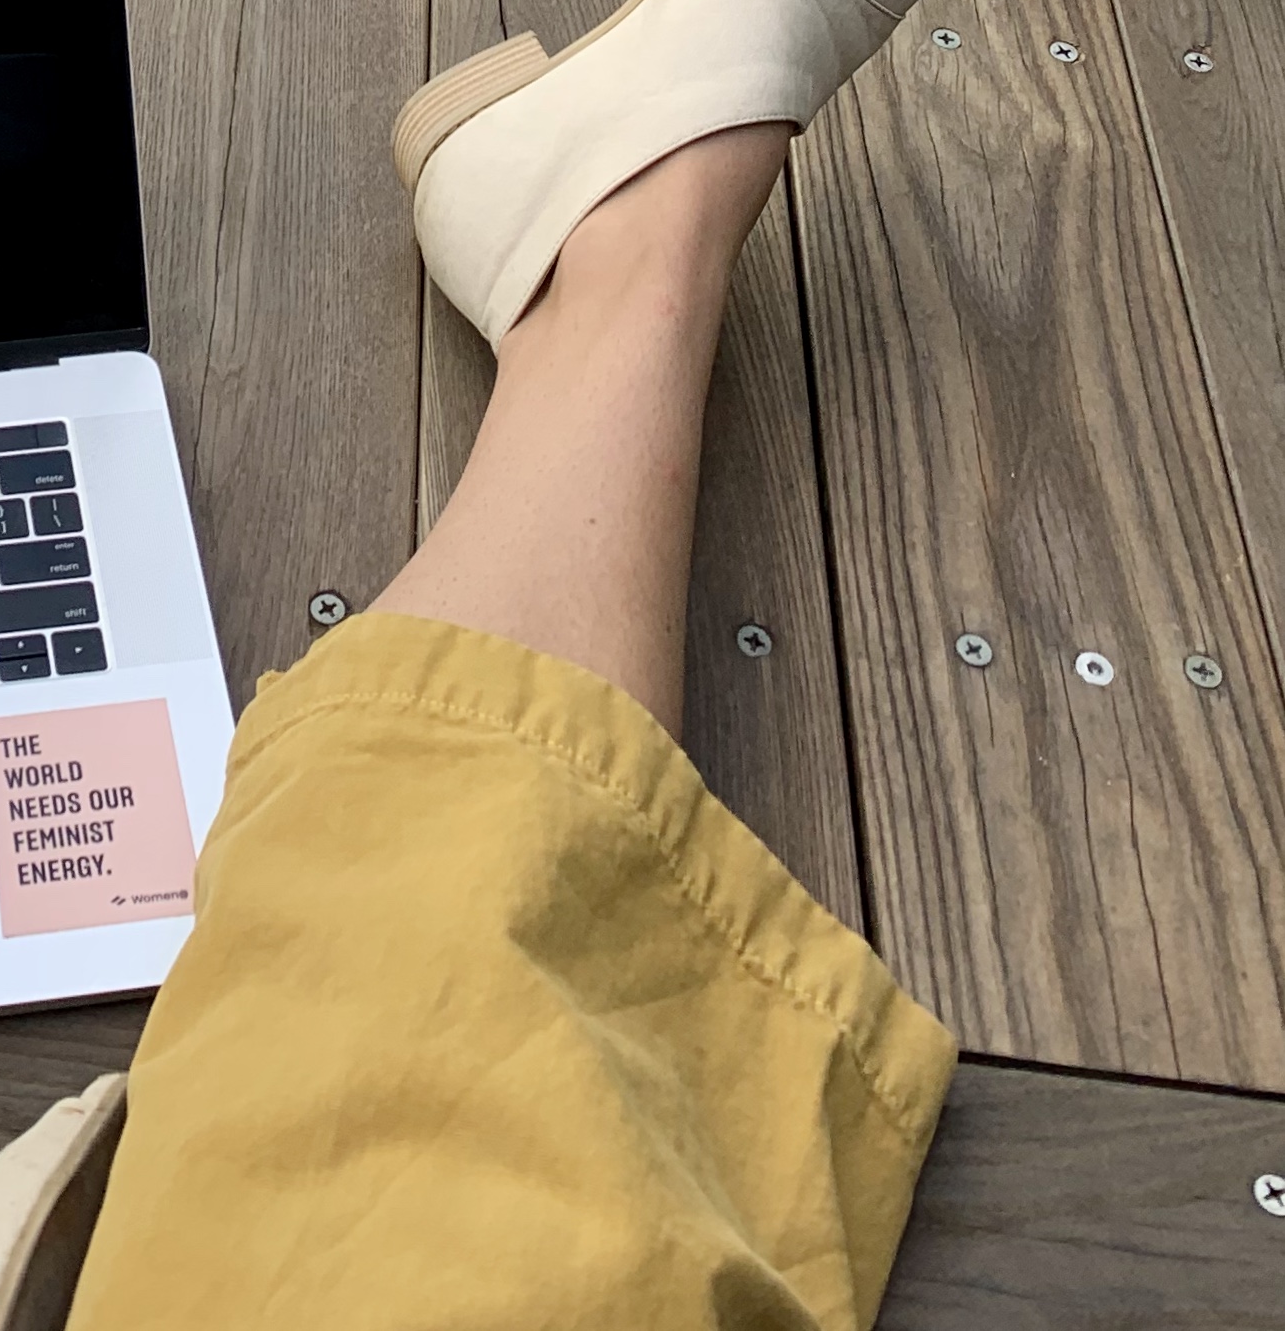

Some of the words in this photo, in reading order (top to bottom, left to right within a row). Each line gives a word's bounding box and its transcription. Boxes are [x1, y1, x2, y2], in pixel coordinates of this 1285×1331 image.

[35, 474, 64, 485] delete
[49, 563, 80, 573] return
[64, 607, 87, 618] shift
[0, 734, 42, 759] THE
[3, 760, 83, 789] WORLD
[8, 792, 82, 821] NEEDS
[88, 786, 135, 811] OUR
[13, 819, 114, 853] FEMINIST
[17, 853, 112, 886] ENERGY.
